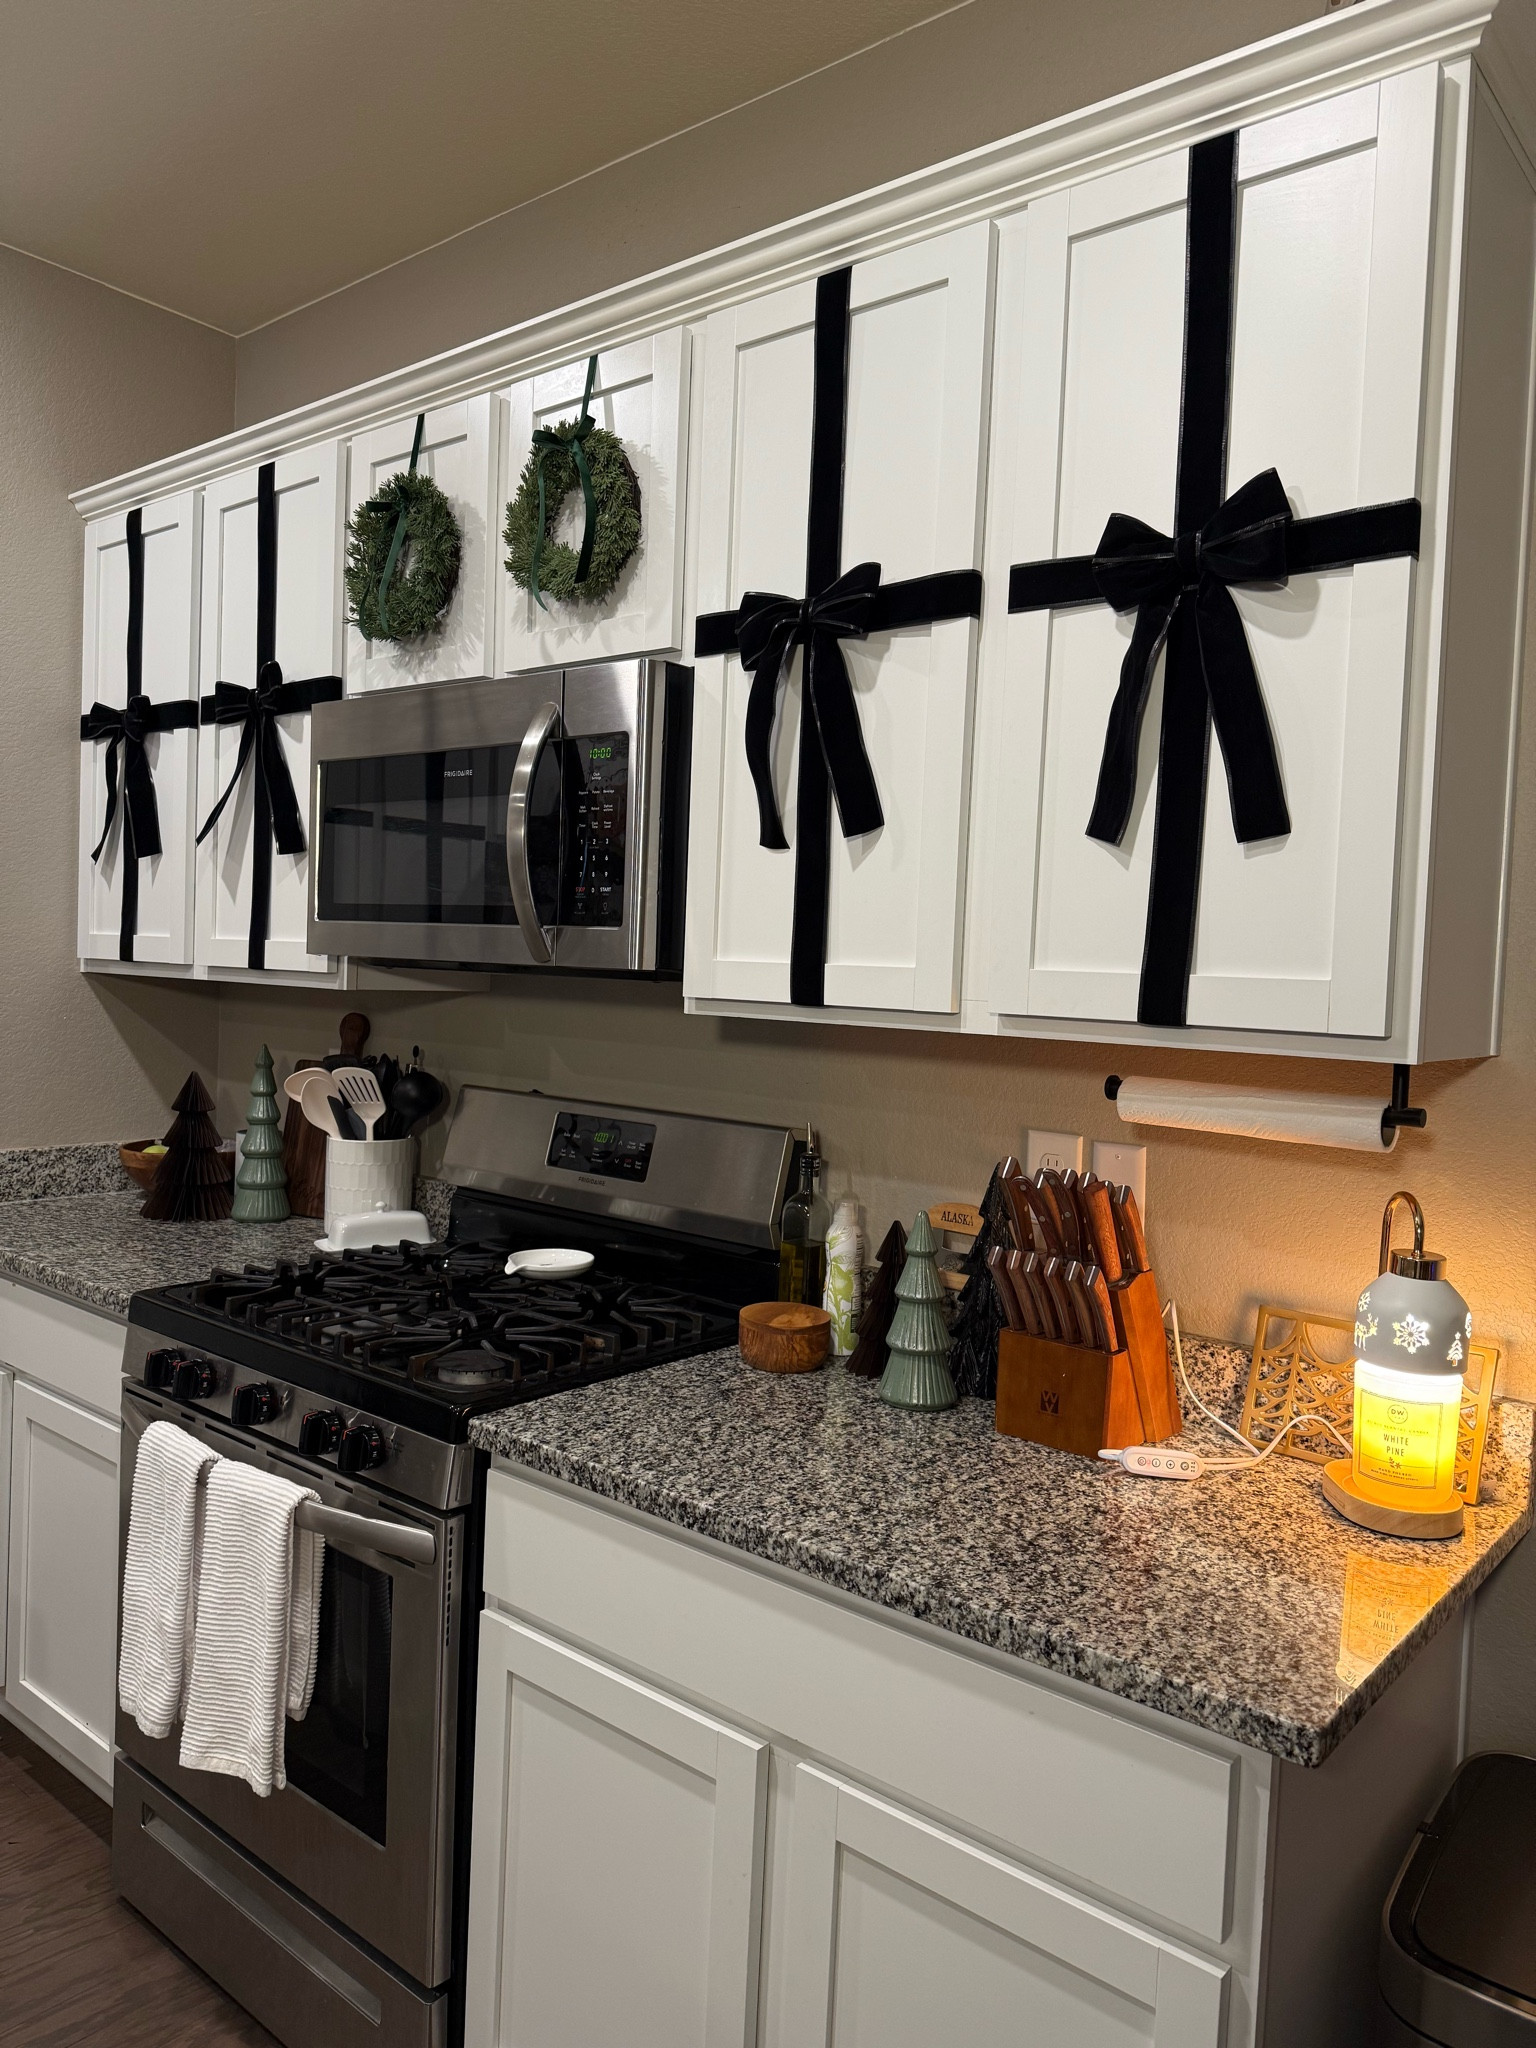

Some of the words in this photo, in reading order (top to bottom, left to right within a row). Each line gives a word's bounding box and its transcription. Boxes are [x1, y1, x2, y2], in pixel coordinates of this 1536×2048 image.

[589, 747, 612, 759] 10:00
[444, 769, 473, 777] FRIGIDAIRE
[578, 1176, 606, 1187] FRIGIDAIRE
[941, 1210, 974, 1226] ALASKA
[1383, 1433, 1409, 1446] WHITE
[1386, 1445, 1405, 1457] PINE
